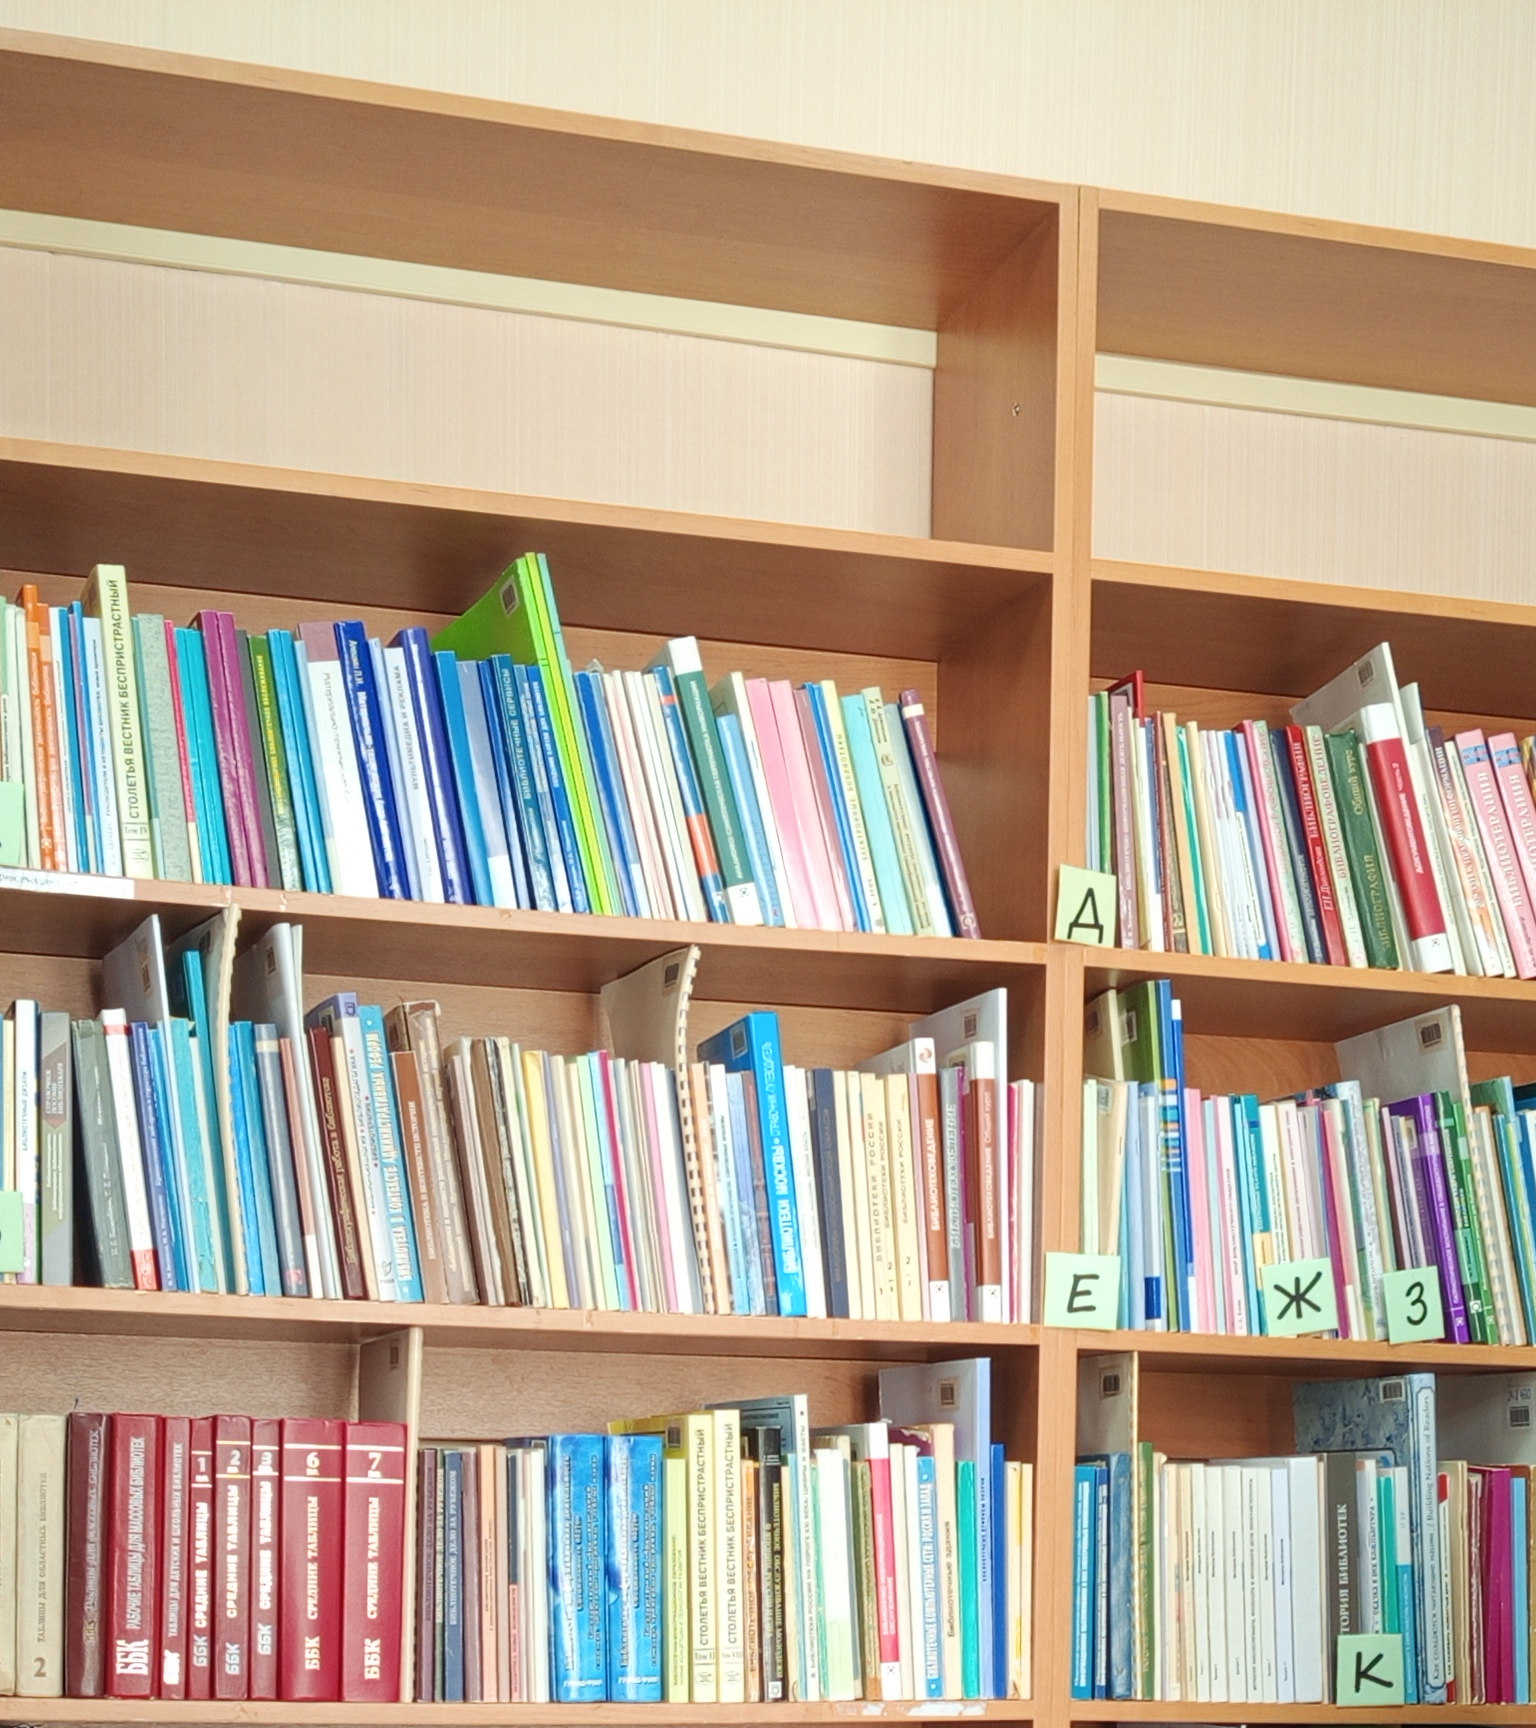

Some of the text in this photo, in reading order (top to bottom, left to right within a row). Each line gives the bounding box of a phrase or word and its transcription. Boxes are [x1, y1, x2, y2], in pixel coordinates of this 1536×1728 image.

[106, 578, 140, 819] СТОЛЕТЬЯ ВЕСТНИК БЕСПРИСТРАСТНЫЙ
[500, 667, 533, 800] БИБЛИОТЕЧНЫЕ СЕРВИСЫ
[1292, 741, 1320, 839] БИБЛИОГРАФИЯ
[1312, 734, 1347, 880] БИБЛИОГРАФОВЕДЕНИЕ
[1476, 769, 1523, 908] БИБЛИОТЕРАПИЯ
[1067, 887, 1104, 943] Д
[364, 1030, 413, 1281] БИБЛИОТЕКА В КОНТЕКСТЕ АДМИНИСТРАТИВНЫХ РЕФОРМ
[770, 1143, 790, 1195] МОСКВЫ
[924, 1117, 940, 1231] БИБЛИОТЕКОВЕДЕНИЕ
[776, 1198, 799, 1273] БИБЛИОТЕКИ
[1067, 1273, 1100, 1313] Е
[1273, 1271, 1323, 1320] Ж
[230, 1450, 241, 1467] 2
[307, 1452, 320, 1469] 6
[368, 1452, 381, 1469] 7
[1422, 1394, 1435, 1521] Building Nations of Readers
[125, 1436, 147, 1630] РАБОЧИЕ ТАБЛИЦЫ ДЛЯ МАССОВЫХ БИБЛИОТЕК
[226, 1484, 239, 1618] СРЕДНИЕ ТАБЛИЦЫ
[365, 1495, 381, 1620] СРЕДНИЕ ТАБЛИЦЫ
[694, 1428, 709, 1646] СТОЛЕТЬЯ ВЕСТНИК БЕСПРИСТРАСТНЫЙ
[1335, 1503, 1350, 1634] ТОРИЯ БИБЛИОТЕК
[116, 1639, 150, 1676] ББК
[225, 1643, 242, 1676] ББК
[363, 1638, 381, 1681] ББК
[1354, 1651, 1394, 1694] К
[1429, 1612, 1440, 1660] создаются
[1430, 1662, 1440, 1680] Как
